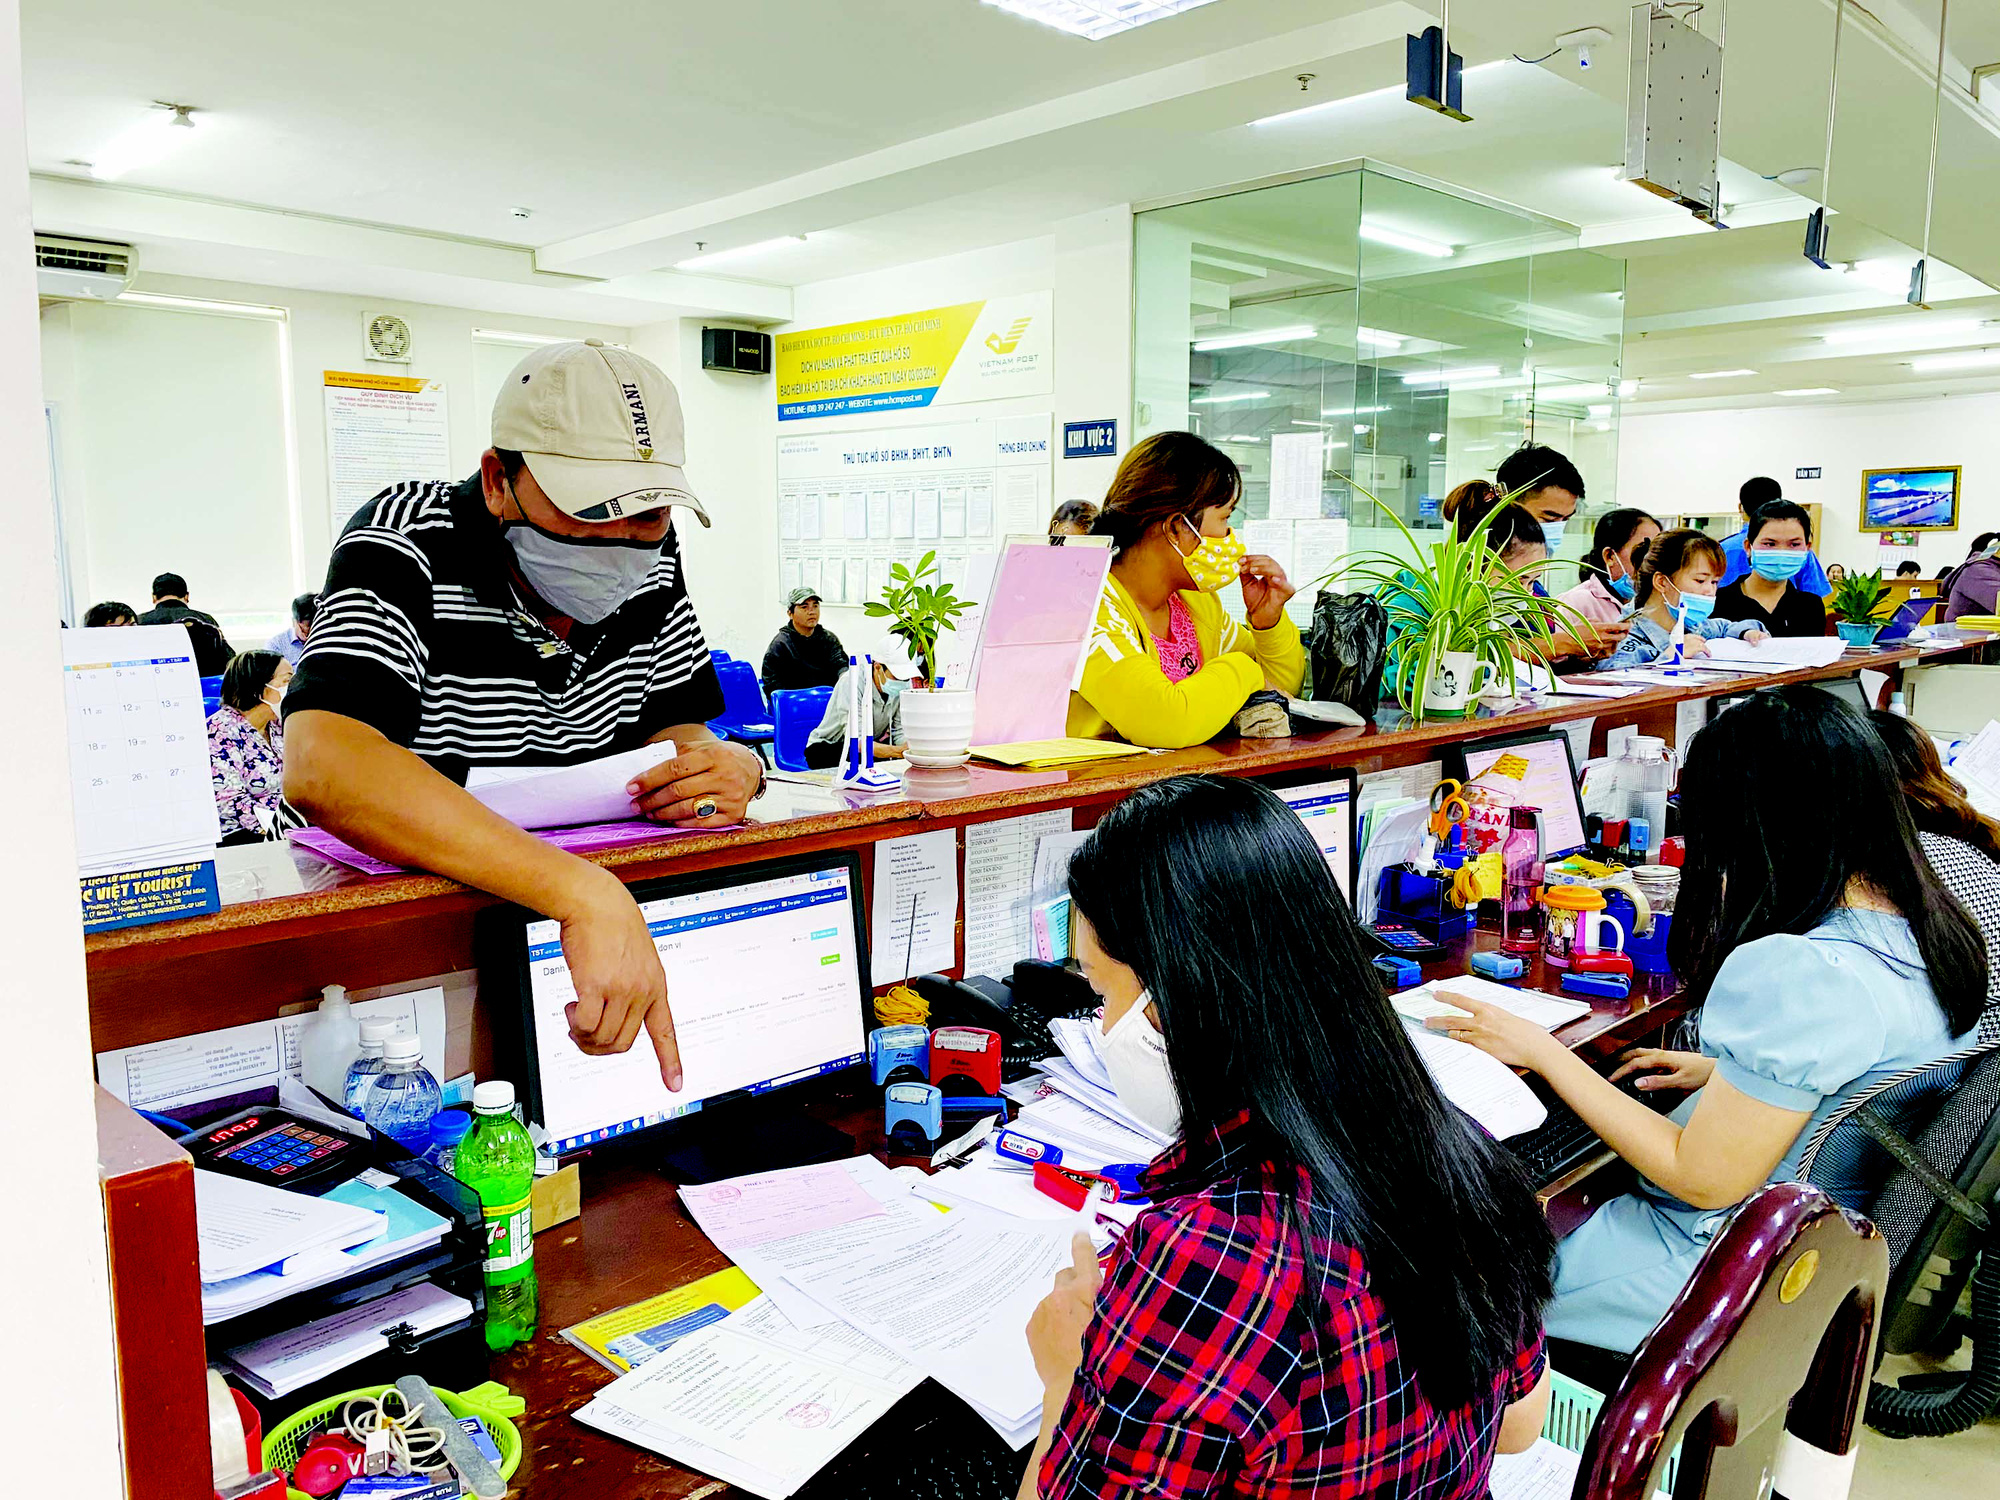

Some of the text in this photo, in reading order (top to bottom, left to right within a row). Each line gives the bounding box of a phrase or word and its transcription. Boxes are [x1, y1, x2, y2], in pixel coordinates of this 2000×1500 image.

[979, 354, 1039, 368] VIETNAM POST
[622, 384, 652, 448] ARMANI
[1068, 426, 1113, 451] KHU VỰC 2
[913, 448, 931, 460] BHYT,
[934, 446, 952, 458] BHTN
[96, 883, 129, 900] VIỆT
[132, 874, 192, 895] TOURIST
[543, 965, 565, 976] Danh
[485, 1220, 506, 1245] 7 up
